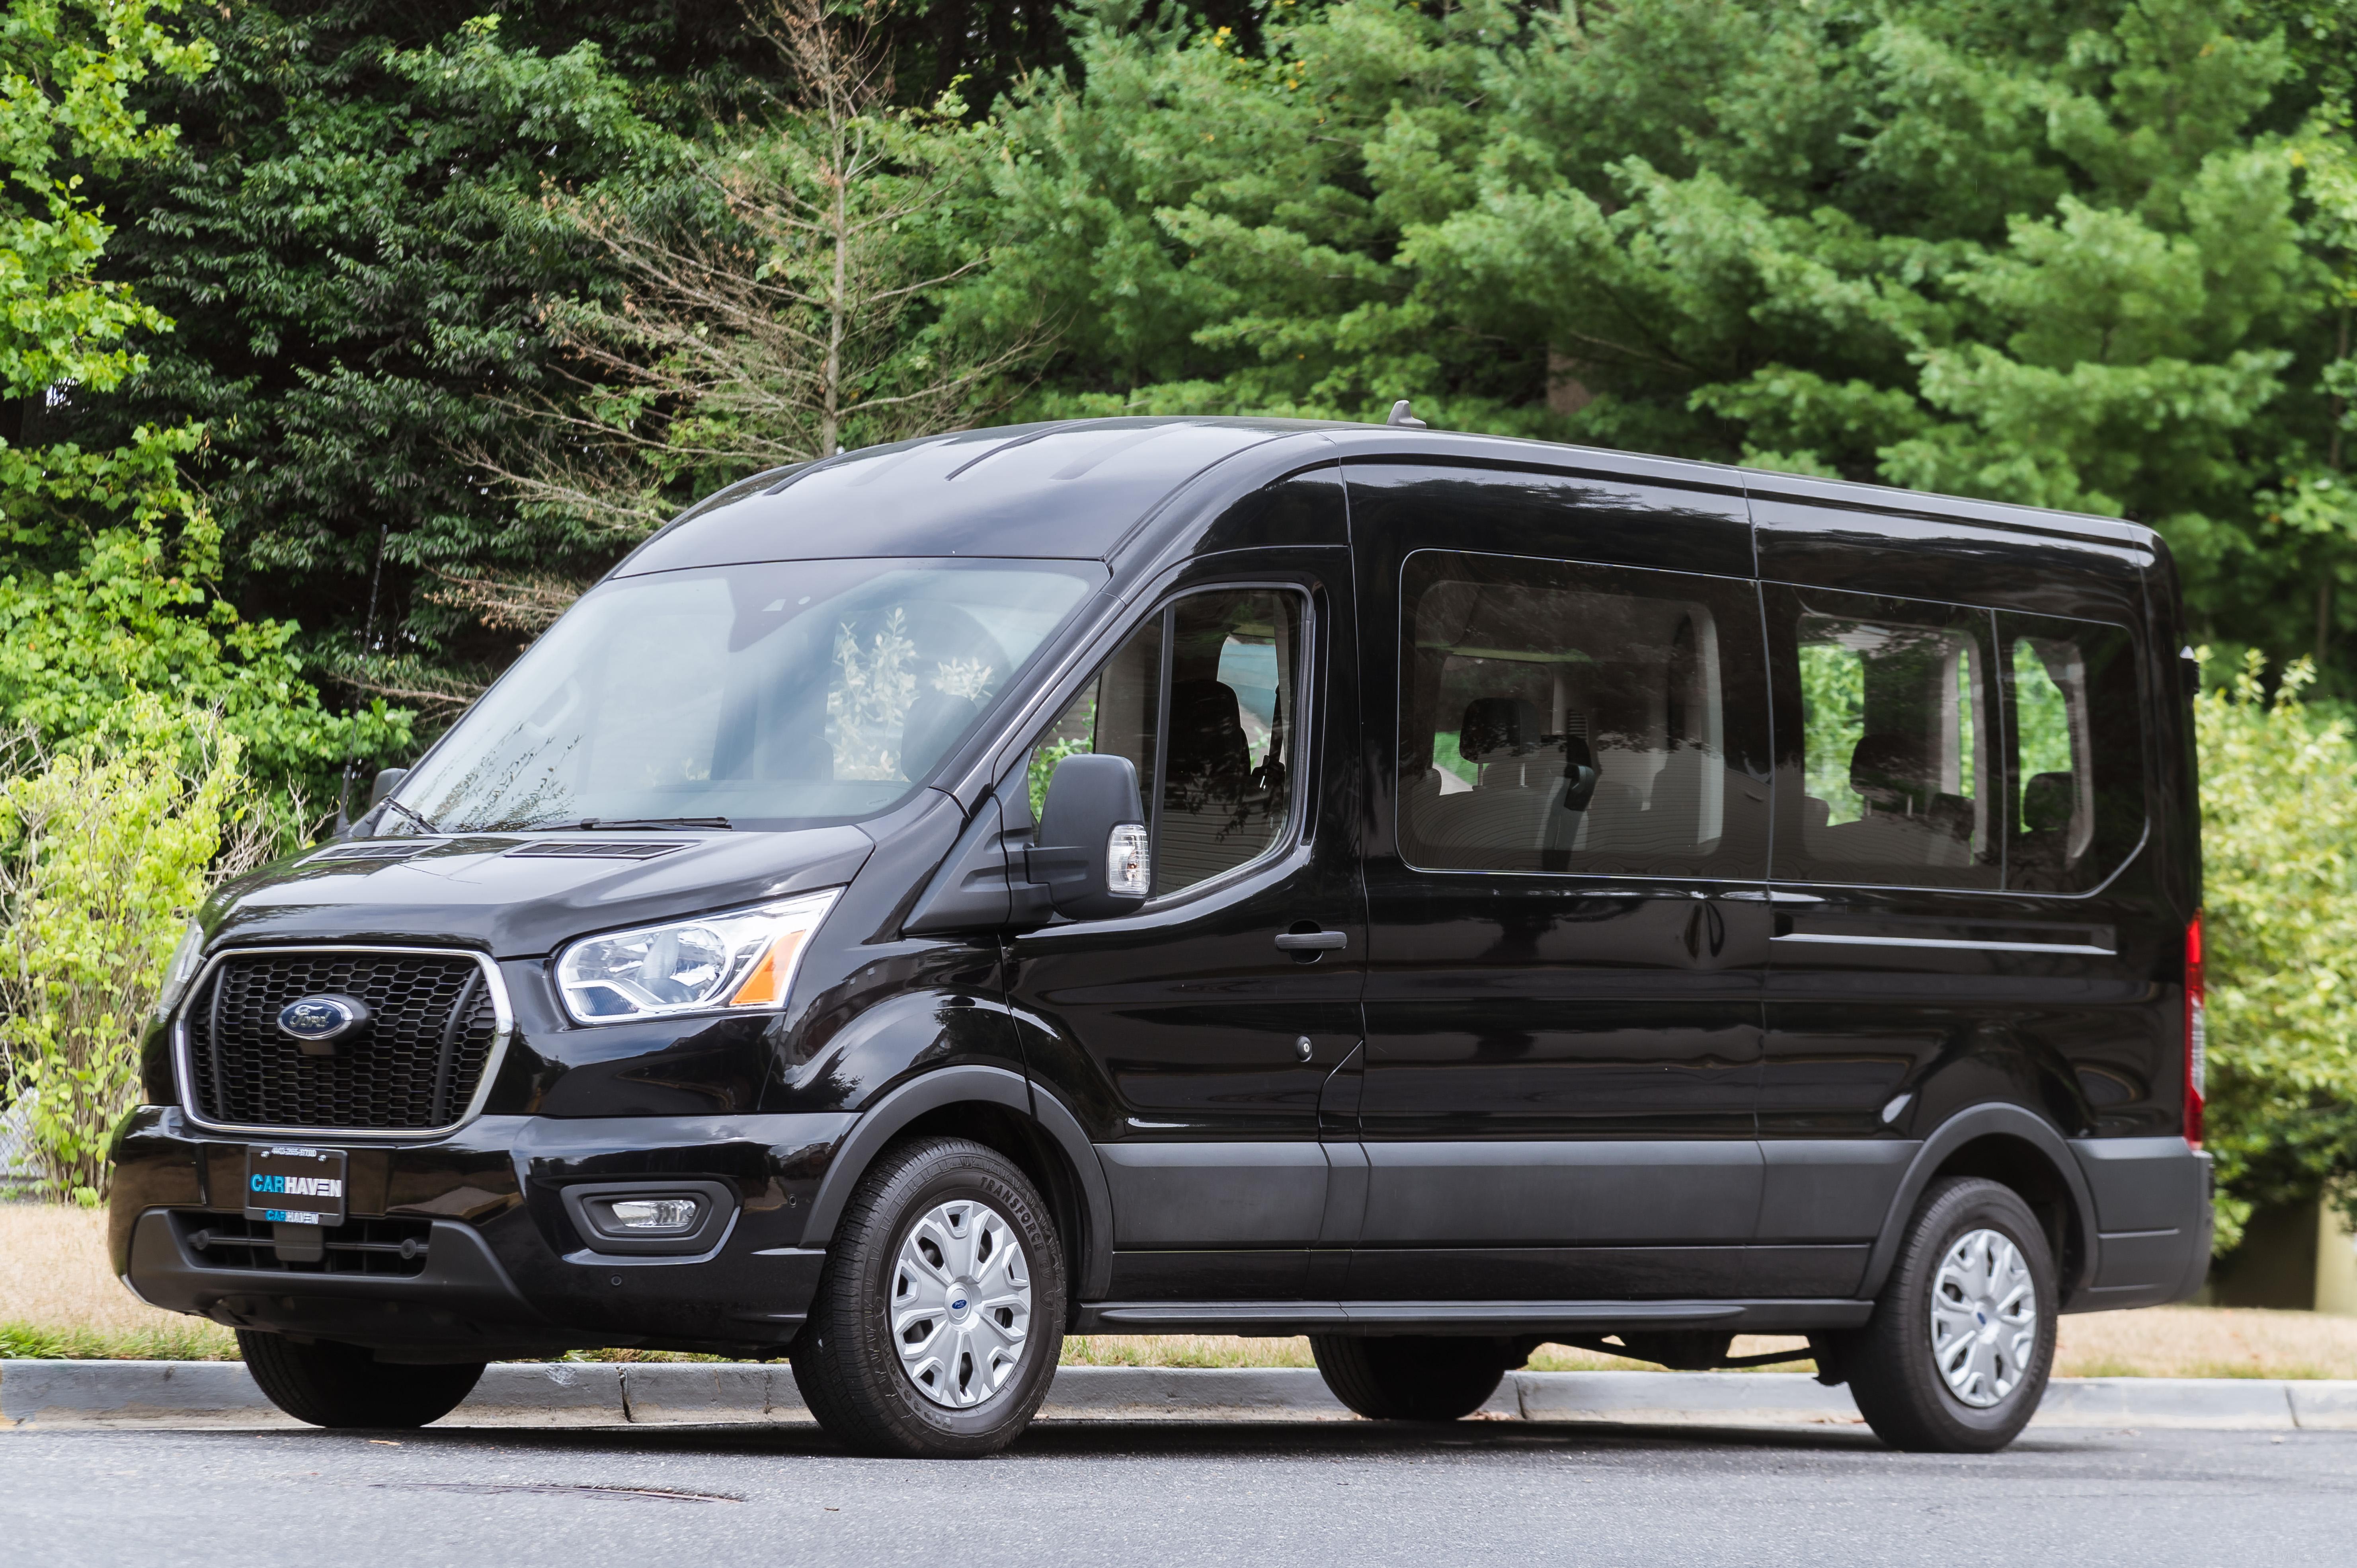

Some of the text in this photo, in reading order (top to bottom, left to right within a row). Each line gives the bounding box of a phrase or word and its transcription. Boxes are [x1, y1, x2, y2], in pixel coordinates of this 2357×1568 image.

[289, 1004, 332, 1028] Ford
[250, 1174, 341, 1197] CARHAVEN
[265, 1209, 318, 1224] CARHAVEN
[979, 1176, 1045, 1252] TRANSFORCE
